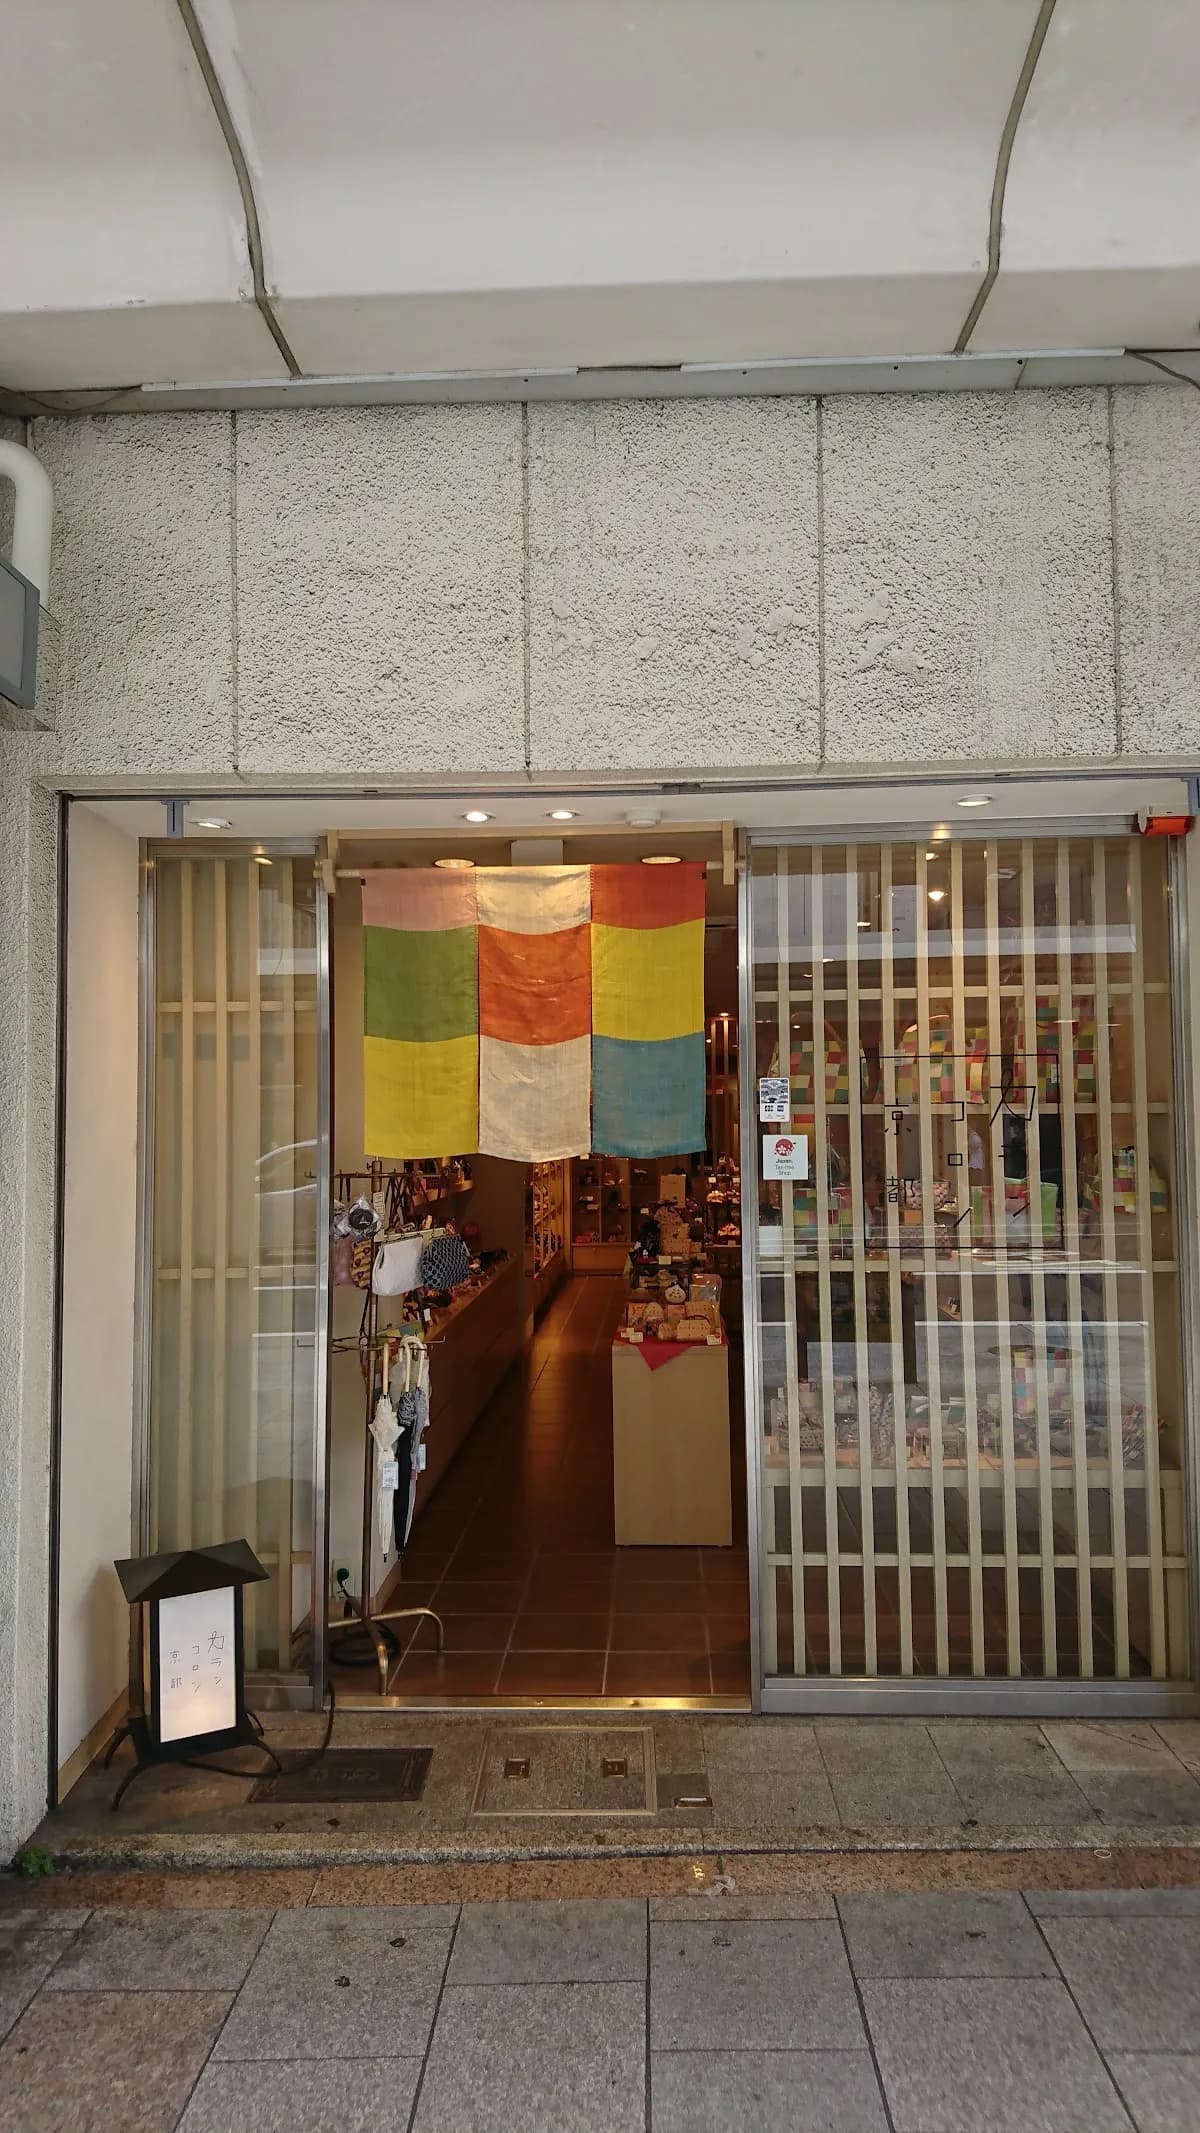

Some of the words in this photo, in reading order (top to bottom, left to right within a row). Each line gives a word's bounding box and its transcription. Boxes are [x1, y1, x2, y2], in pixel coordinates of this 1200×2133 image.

[883, 1097, 922, 1205] 京都
[944, 1100, 974, 1229] コロン
[169, 1650, 182, 1689] 京都
[191, 1645, 201, 1695] コロン
[207, 1630, 225, 1685] カラン
